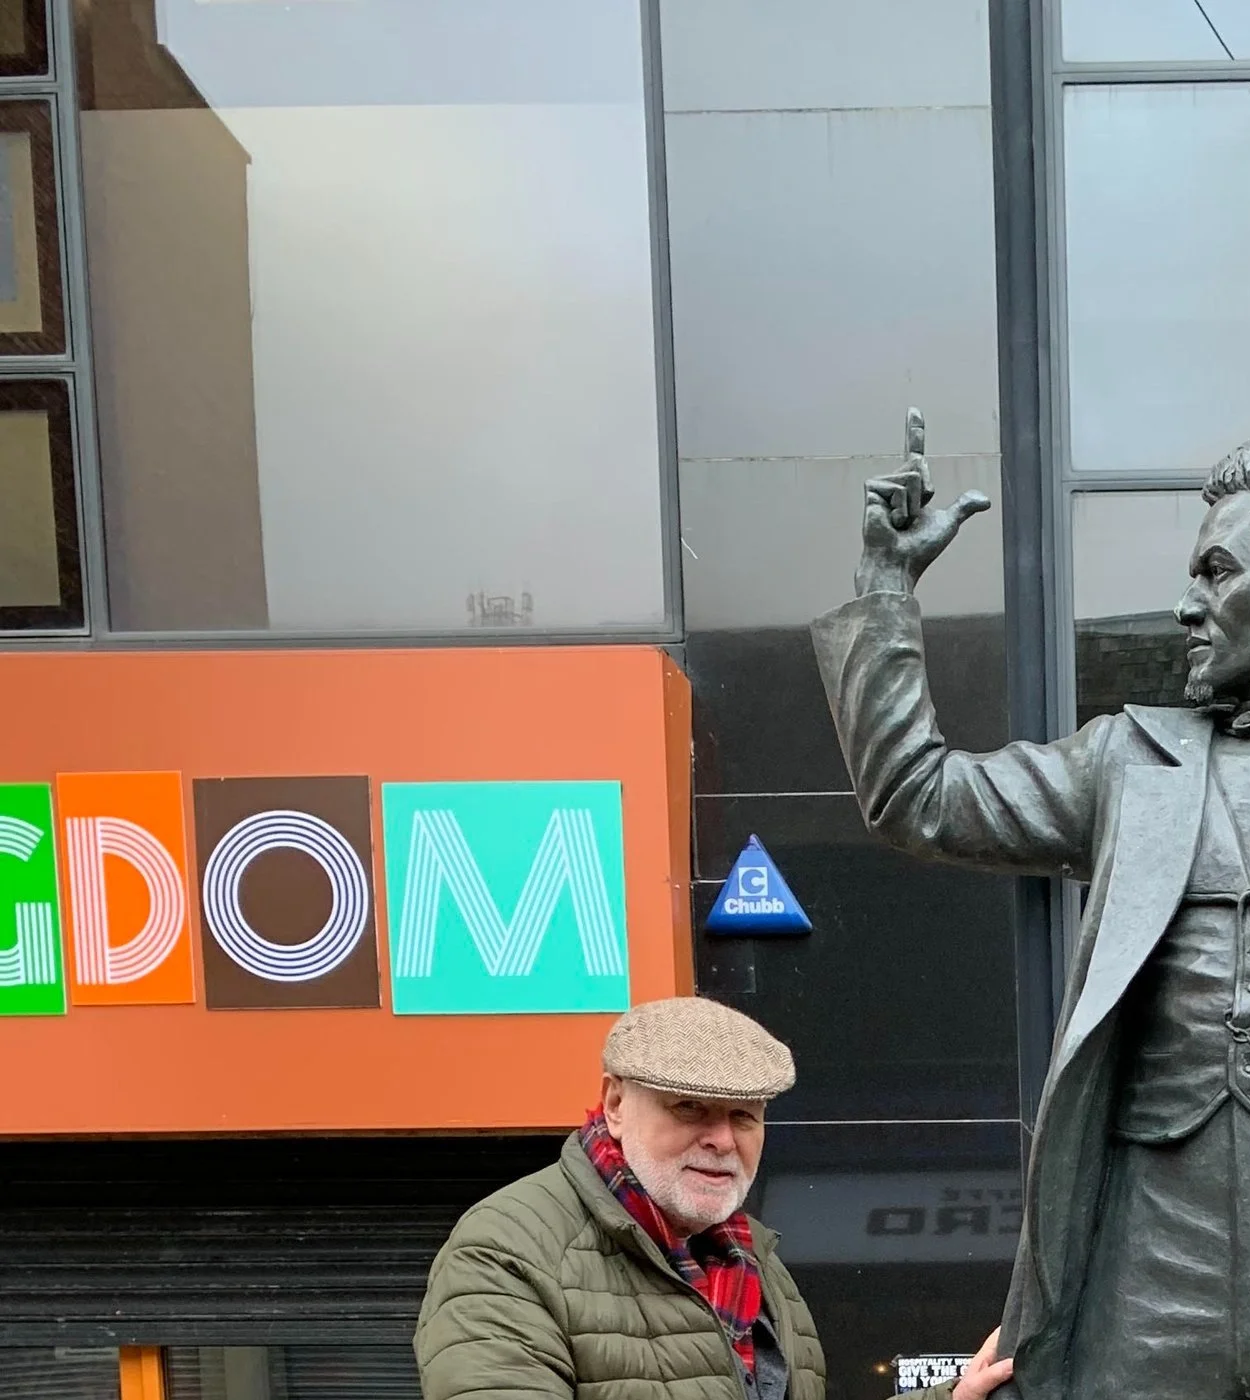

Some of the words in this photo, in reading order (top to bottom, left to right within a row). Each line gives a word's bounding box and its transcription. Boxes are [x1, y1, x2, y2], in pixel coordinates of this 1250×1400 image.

[724, 898, 785, 914] Chubb
[899, 1366, 929, 1376] GIVE
[932, 1366, 957, 1376] THE
[899, 1376, 917, 1388] ON
